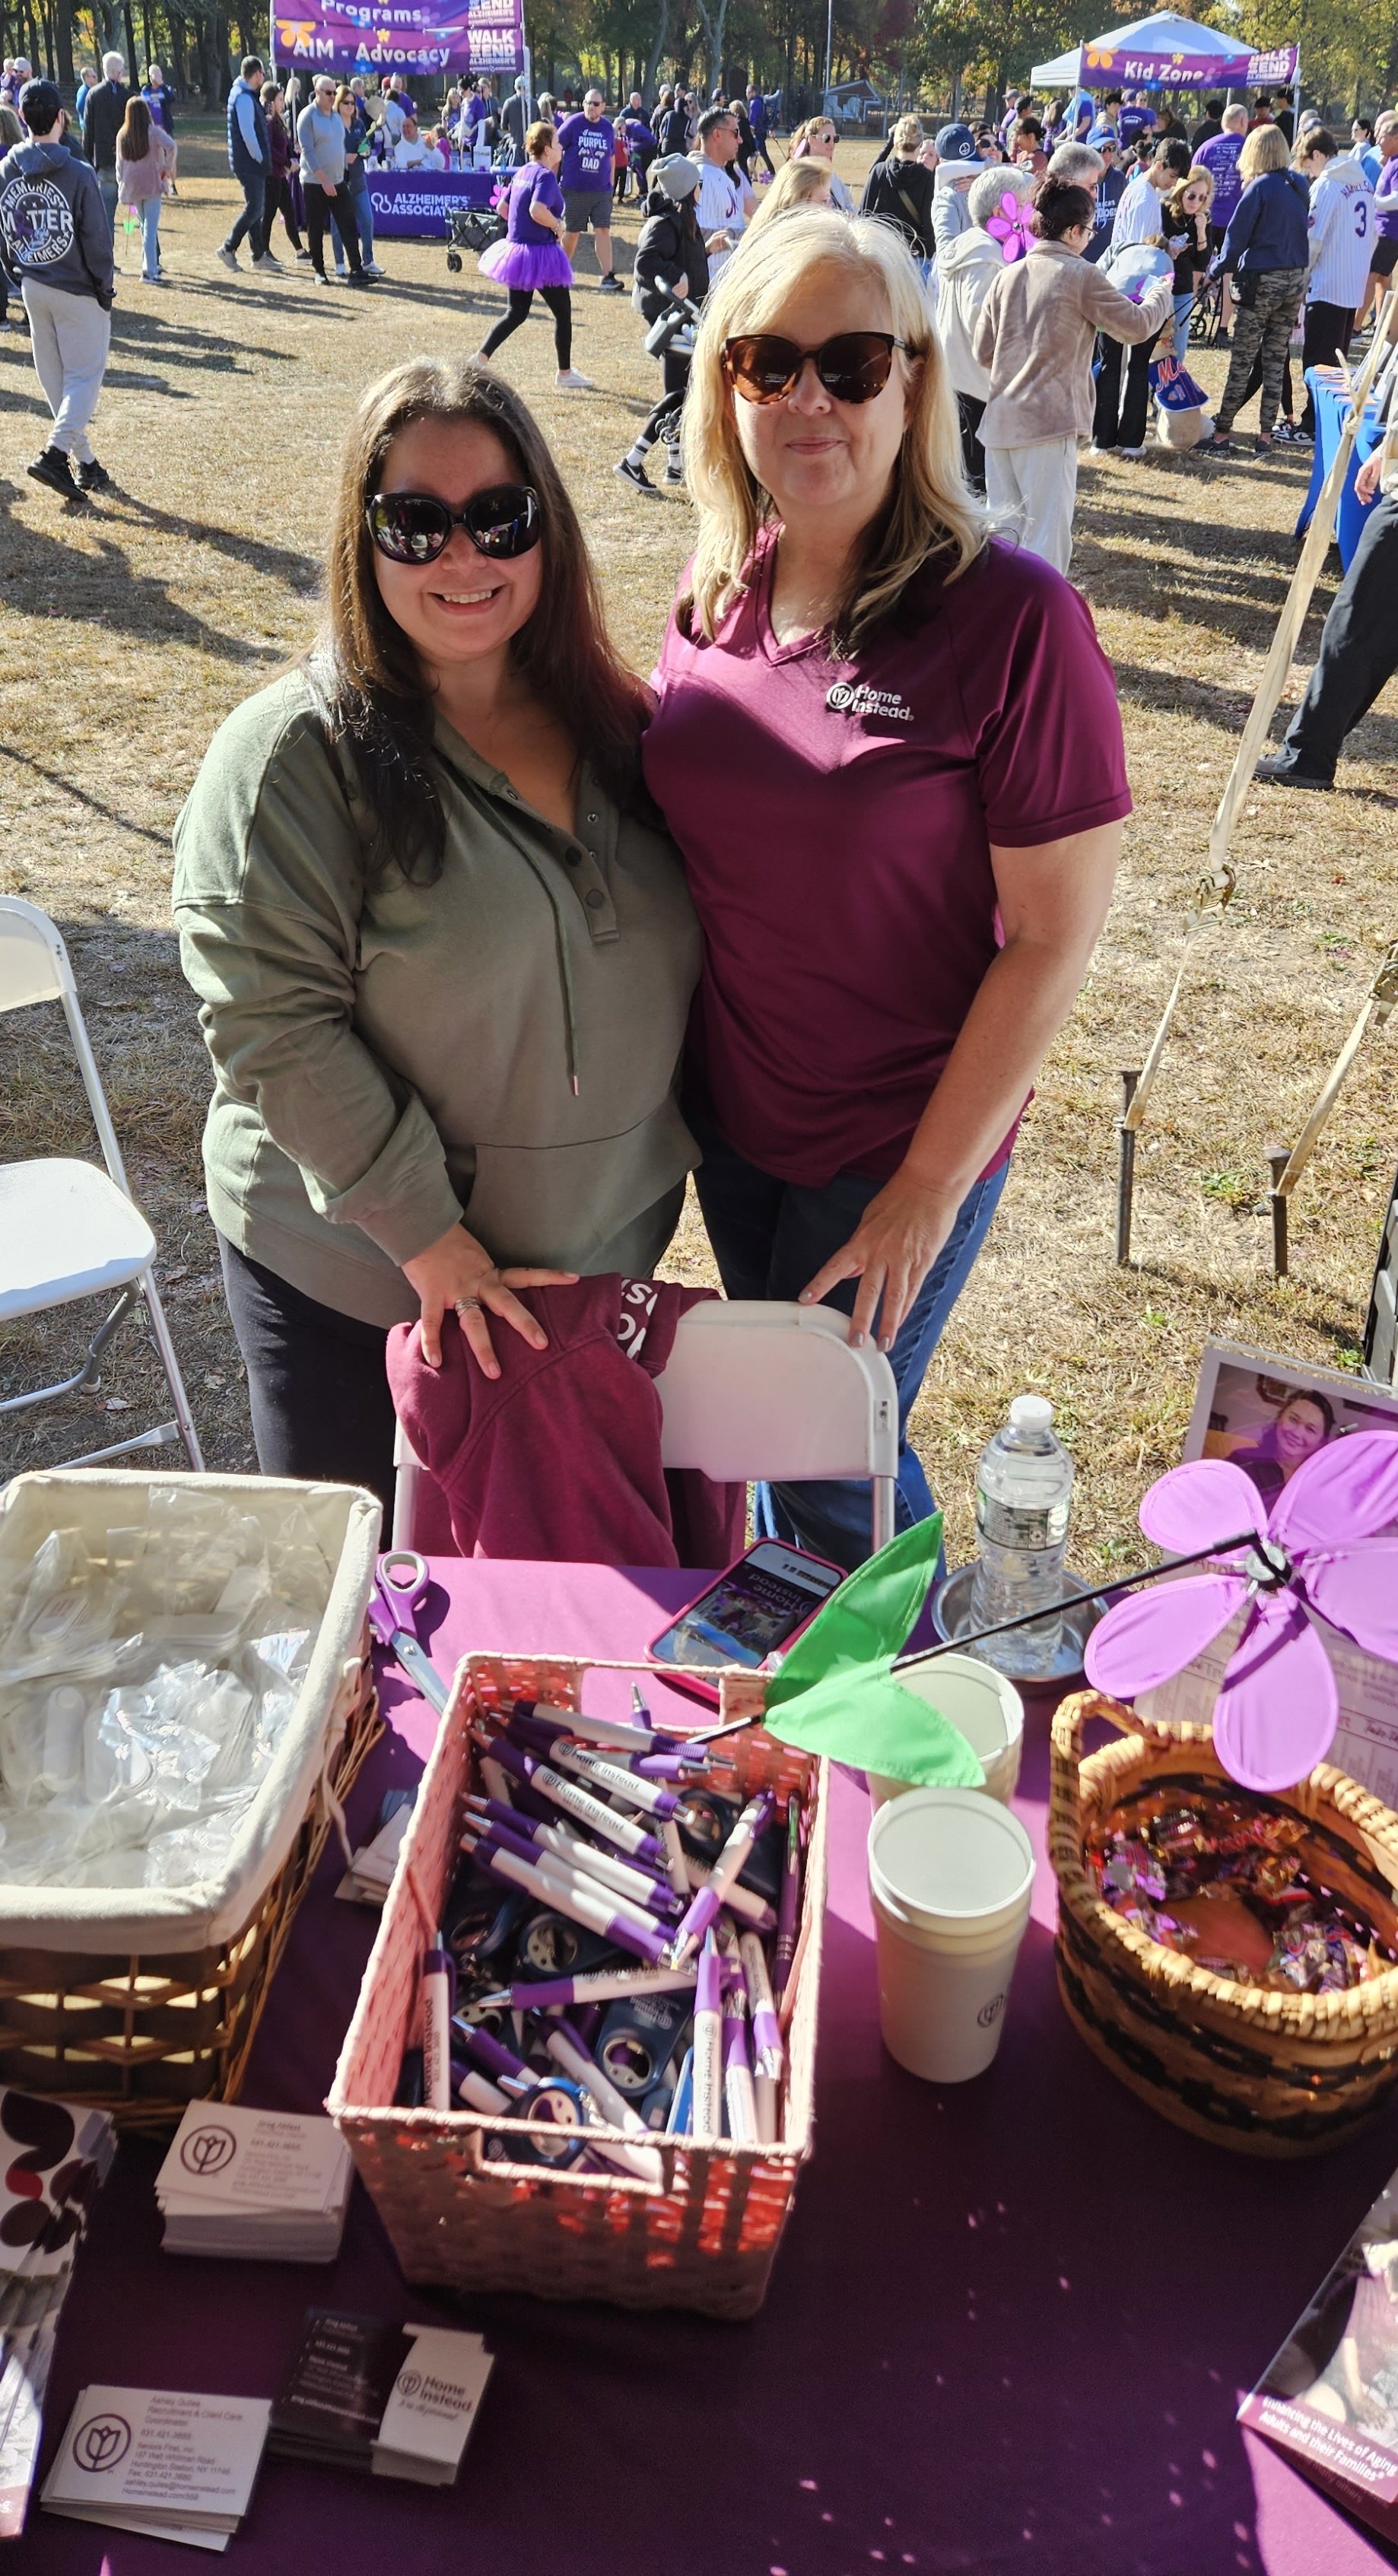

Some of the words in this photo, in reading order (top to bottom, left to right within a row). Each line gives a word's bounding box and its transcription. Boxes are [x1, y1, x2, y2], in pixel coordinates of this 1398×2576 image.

[321, 0, 422, 23] Programs
[467, 29, 515, 45] WALK
[293, 39, 335, 59] AIM
[355, 43, 450, 67] Advocacy
[481, 44, 516, 58] END
[1124, 60, 1155, 81] Kid
[1158, 64, 1205, 84] Zone
[1259, 60, 1290, 74] END
[578, 135, 608, 150] PURPLE
[582, 157, 599, 170] DAD
[392, 204, 467, 217] ASSOCIAT
[394, 192, 469, 206] ALZHEIMER'S
[2, 208, 75, 234] MTTER
[1355, 201, 1366, 238] 3
[856, 684, 902, 704] Home
[748, 1573, 801, 1602] Instead
[753, 1583, 796, 1609] Home
[571, 1749, 601, 1770] Home
[601, 1764, 640, 1792] Instead
[555, 1780, 586, 1804] Home
[586, 1799, 624, 1832] Instead
[424, 1997, 434, 2053] Instead
[424, 2375, 467, 2396] Home
[420, 2389, 472, 2412] Instead
[1258, 2411, 1291, 2435] Adults
[1288, 2427, 1311, 2444] and
[1308, 2436, 1336, 2457] their
[1262, 2395, 1311, 2429] Enhancing
[1311, 2418, 1329, 2436] the
[1327, 2428, 1355, 2452] Lives
[1354, 2444, 1368, 2458] of
[1365, 2451, 1398, 2478] Aging
[130, 2461, 168, 2471] Huntington
